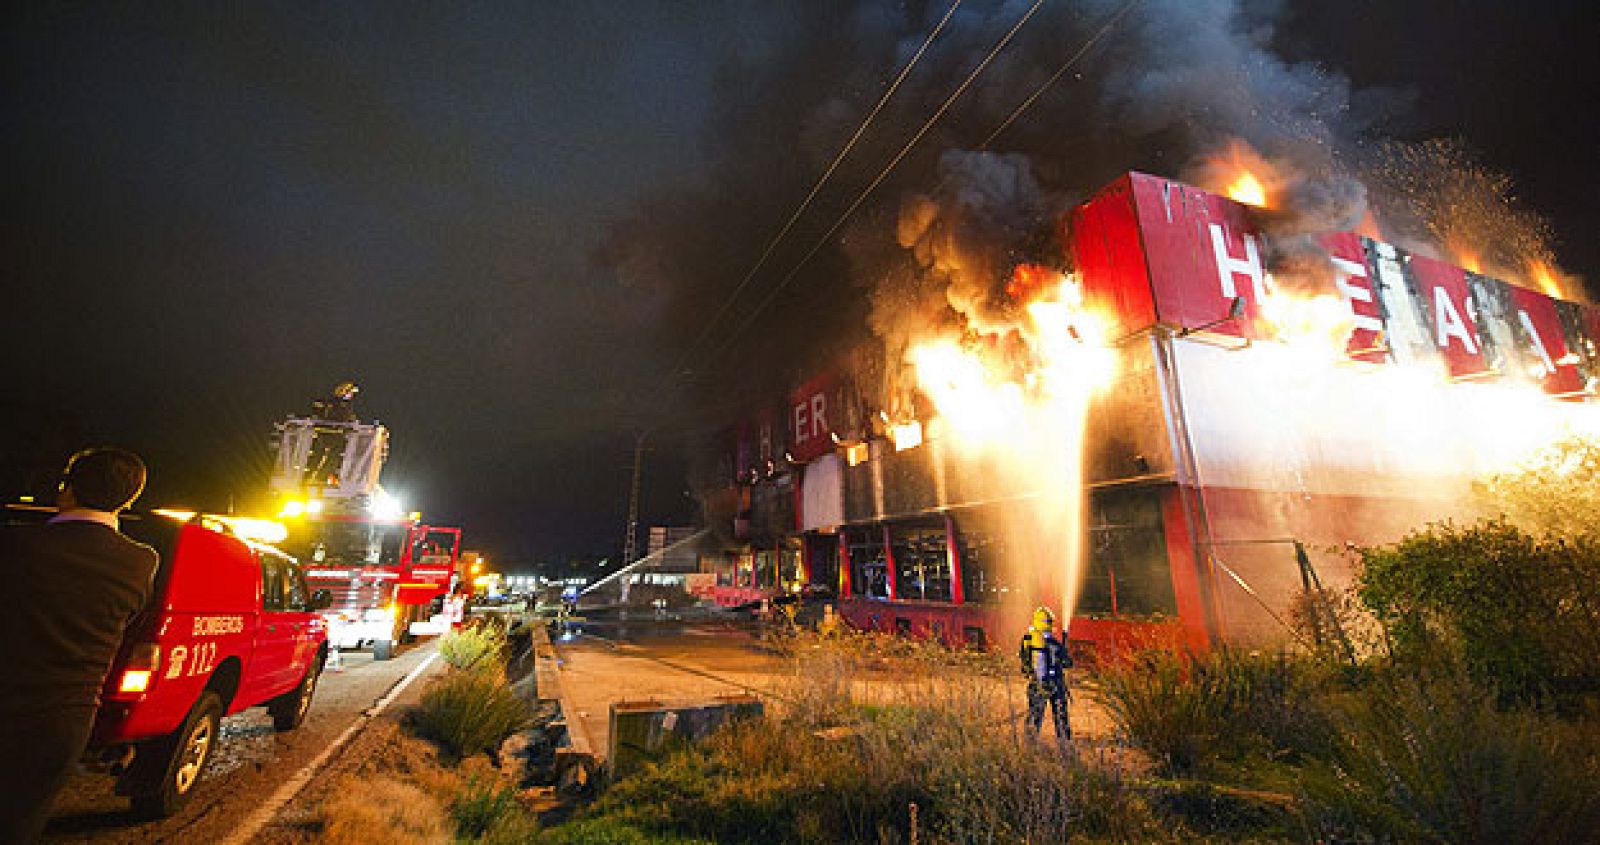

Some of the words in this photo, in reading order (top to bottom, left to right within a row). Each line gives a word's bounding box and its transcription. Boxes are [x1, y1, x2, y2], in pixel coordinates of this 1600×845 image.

[795, 392, 829, 447] ER
[191, 616, 244, 636] BOMBEROS
[187, 642, 216, 677] 112
